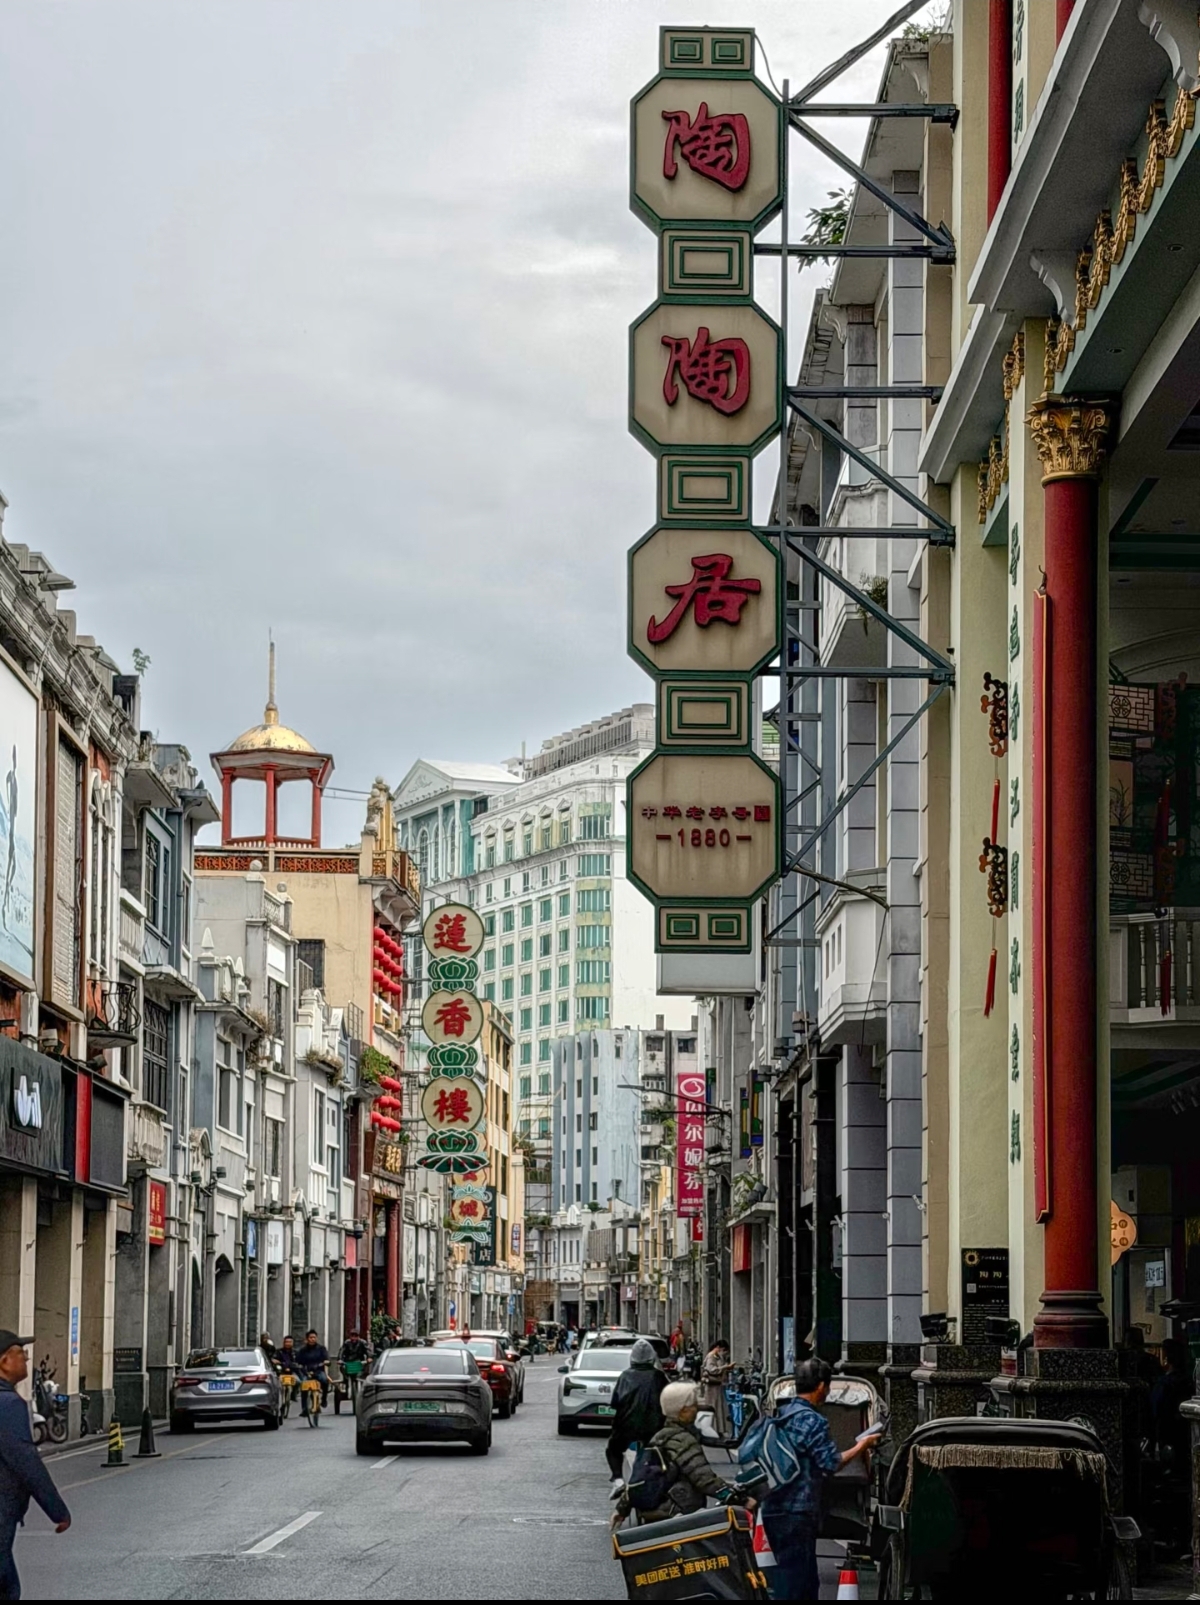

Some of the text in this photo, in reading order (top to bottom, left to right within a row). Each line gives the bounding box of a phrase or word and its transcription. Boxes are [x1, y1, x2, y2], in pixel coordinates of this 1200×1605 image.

[648, 102, 761, 644] 陶陶居
[433, 913, 472, 1123] 蓮香樓
[634, 1555, 730, 1587] 美团配送 准时好用
